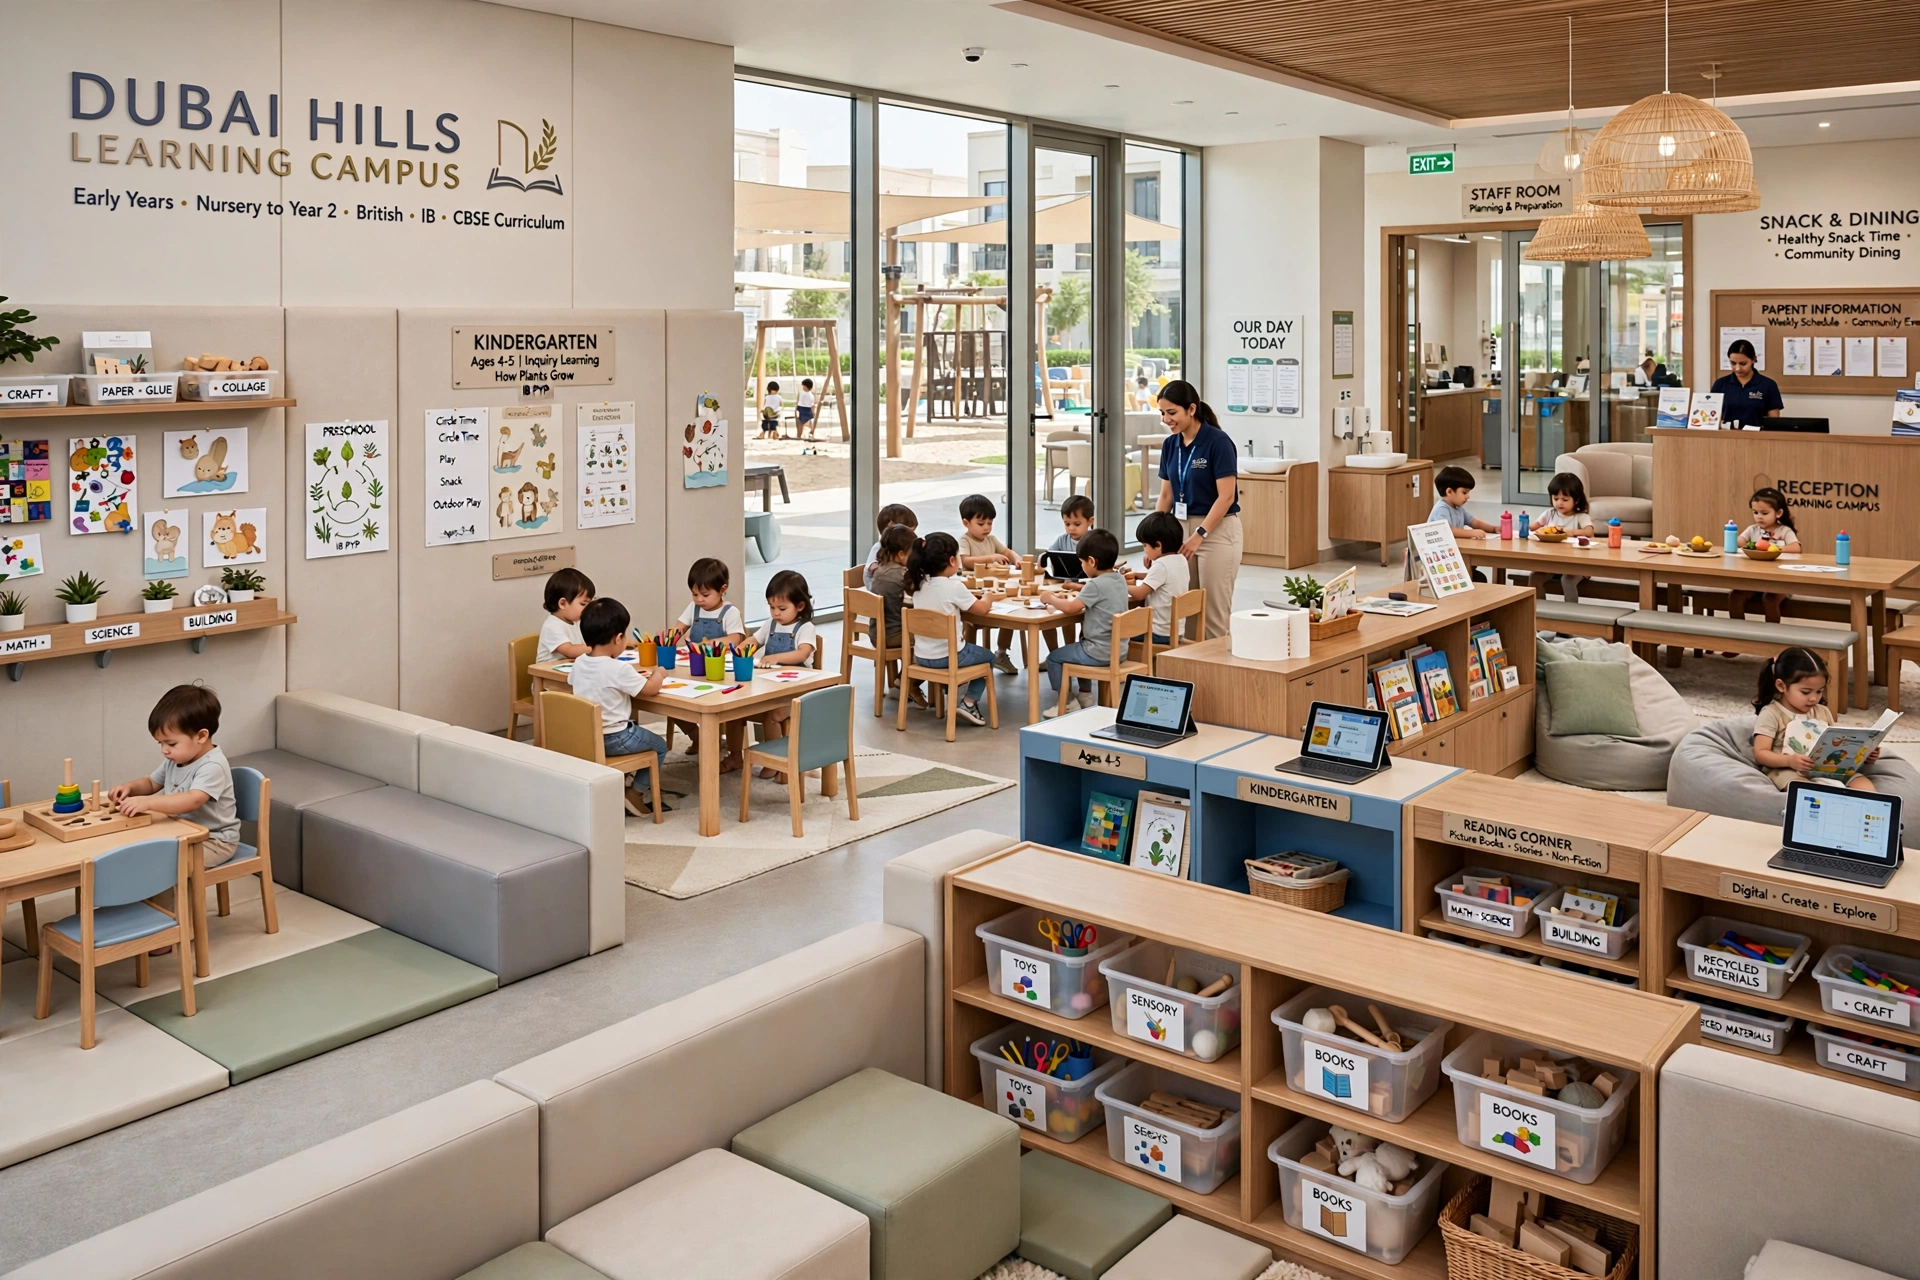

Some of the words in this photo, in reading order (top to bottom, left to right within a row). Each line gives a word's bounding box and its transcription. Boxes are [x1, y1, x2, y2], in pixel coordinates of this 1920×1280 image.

[71, 71, 278, 137] DUBAI
[310, 98, 461, 154] HILLS
[71, 131, 292, 177] LEARNING
[311, 152, 461, 190] CAMPUS
[1412, 157, 1437, 172] EXIT
[1471, 187, 1512, 201] STAFF
[1516, 185, 1560, 199] ROOM
[74, 187, 120, 211] Early
[126, 190, 174, 210] Years
[196, 195, 262, 218] Nursery
[267, 201, 284, 216] to
[289, 201, 323, 217] Year
[328, 203, 337, 218] 2
[356, 204, 403, 222] British
[421, 208, 436, 223] IB
[453, 210, 490, 226] CBSE
[494, 212, 565, 230] Curriculum
[1469, 203, 1504, 214] Planning
[1506, 202, 1512, 211] &
[1514, 200, 1563, 213] Preparation
[1760, 214, 1823, 230] SNACK
[1829, 213, 1842, 227] &
[1849, 210, 1920, 226] DINING
[1777, 232, 1825, 246] Healthy
[1828, 231, 1865, 243] Snack
[1869, 231, 1901, 242] Time
[1784, 248, 1855, 261] Community
[1859, 247, 1901, 260] Dining
[1811, 303, 1902, 315] INFORMATION
[1233, 320, 1262, 334] OUR
[1266, 320, 1294, 334] DAY
[474, 333, 597, 350] KINDERGARTEN
[1240, 337, 1286, 350] TODAY
[470, 356, 495, 370] Ages
[497, 355, 515, 367] 4-5
[524, 354, 558, 368] Inquiry
[560, 354, 600, 368] Learning
[495, 371, 517, 382] How
[519, 370, 548, 381] Plants
[550, 369, 575, 381] Grow
[7, 388, 44, 400] CRAFT
[101, 386, 134, 397] PAPER
[145, 385, 173, 396] GLUE
[221, 382, 266, 393] COLLAGE
[439, 455, 456, 466] Play
[440, 476, 463, 487] Snack
[1777, 480, 1879, 498] RECEPTION
[1786, 498, 1833, 509] EARNING
[1836, 500, 1880, 512] CAMPUS
[189, 612, 233, 628] BUILDING
[91, 626, 134, 640] SCIENCE
[6, 639, 37, 652] MATH
[1249, 782, 1338, 811] KINDERGARTEN
[1463, 819, 1517, 840] READING
[1520, 831, 1573, 852] CORNER
[1449, 829, 1477, 845] Picture
[1551, 851, 1602, 870] Non-Fiction
[1732, 882, 1768, 900] Digital
[1781, 893, 1820, 911] Create
[1833, 903, 1877, 921] Explore
[1552, 926, 1601, 947] BUILDING
[1013, 958, 1038, 975] TOYS
[1703, 954, 1760, 975] RECYCLED
[1697, 964, 1760, 988] MATERIALS
[1131, 993, 1178, 1017] SENSORY
[1854, 1001, 1895, 1019] CRAFT
[1314, 1048, 1355, 1072] BOOKS
[1846, 1052, 1888, 1072] CRAFT
[1008, 1078, 1033, 1096] TOYS
[1492, 1102, 1538, 1126] BOOKS
[1312, 1187, 1353, 1212] BOOKS
